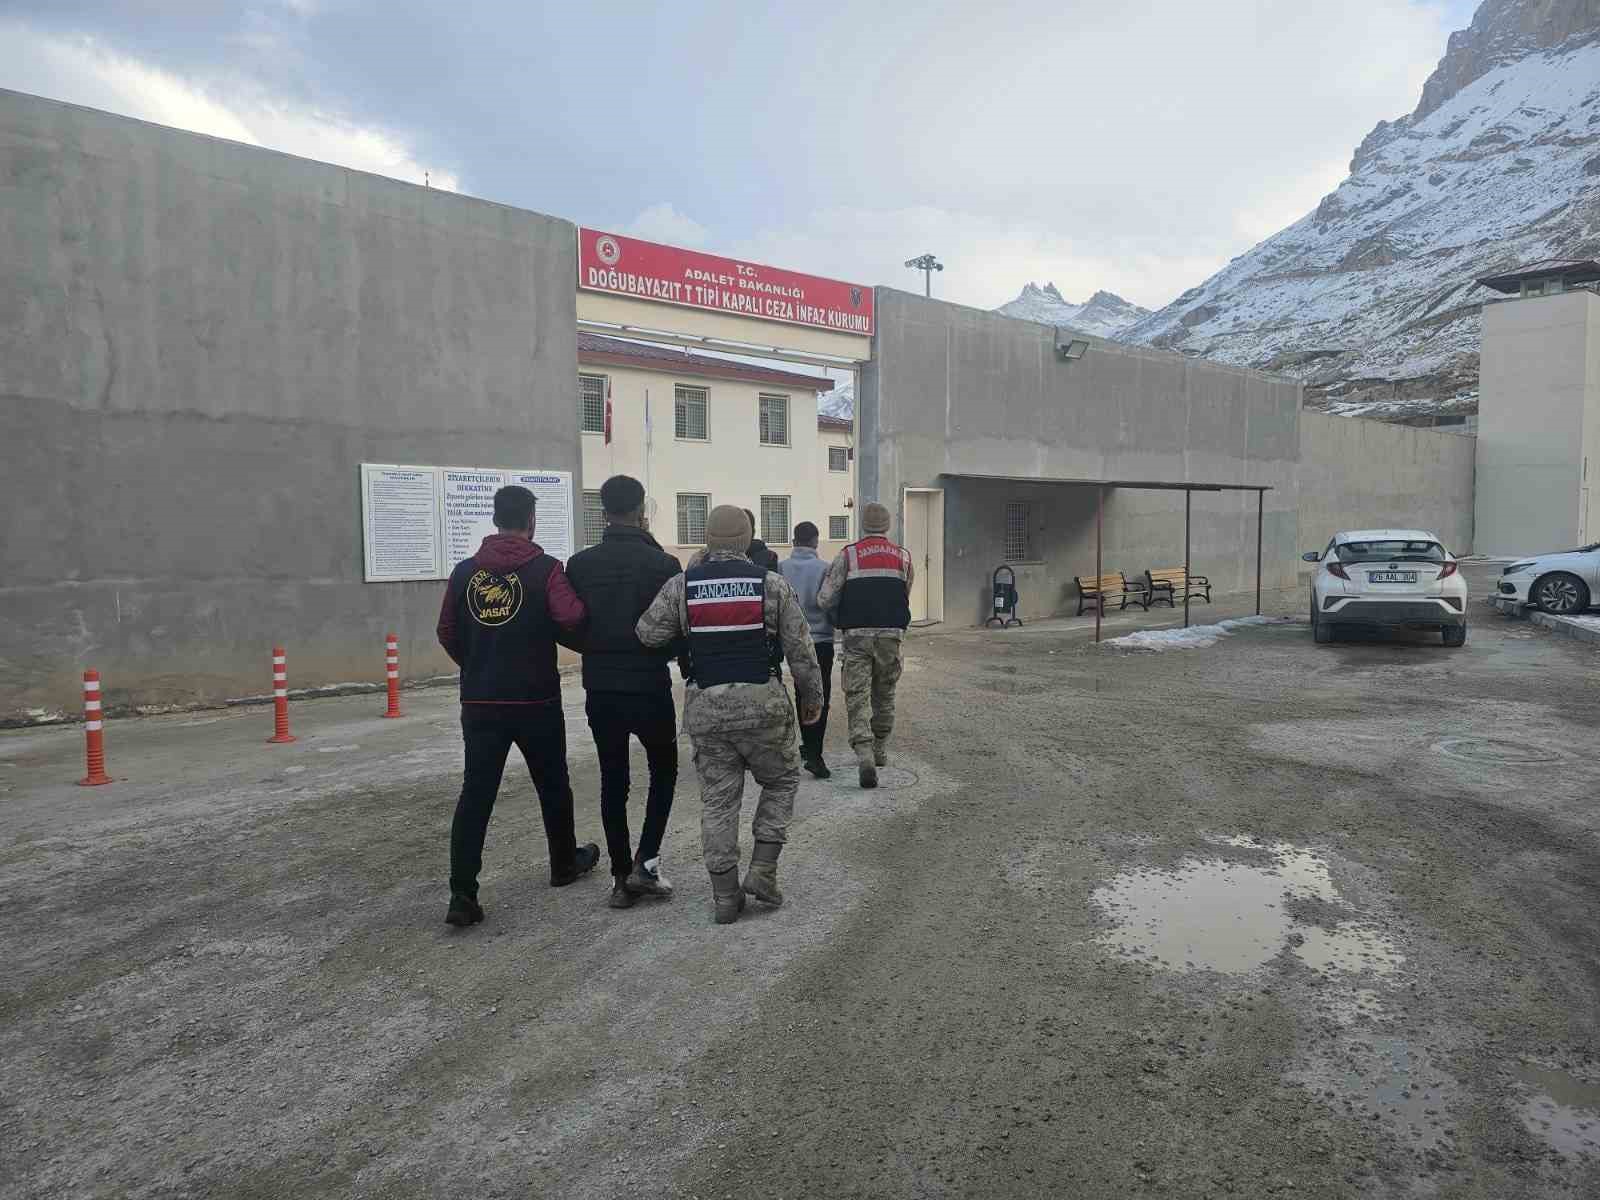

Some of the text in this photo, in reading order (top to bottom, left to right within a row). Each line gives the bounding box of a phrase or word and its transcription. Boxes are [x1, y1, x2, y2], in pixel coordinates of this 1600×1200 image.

[736, 264, 758, 278] T.C.
[684, 267, 805, 300] ADALET BAKANLIĞI
[588, 266, 869, 332] DOĞUBAYAZIT T TİPİ KAPALI CEZA İNFAZ KURUMU
[694, 582, 755, 599] JANDARMA
[479, 607, 511, 618] JASAT
